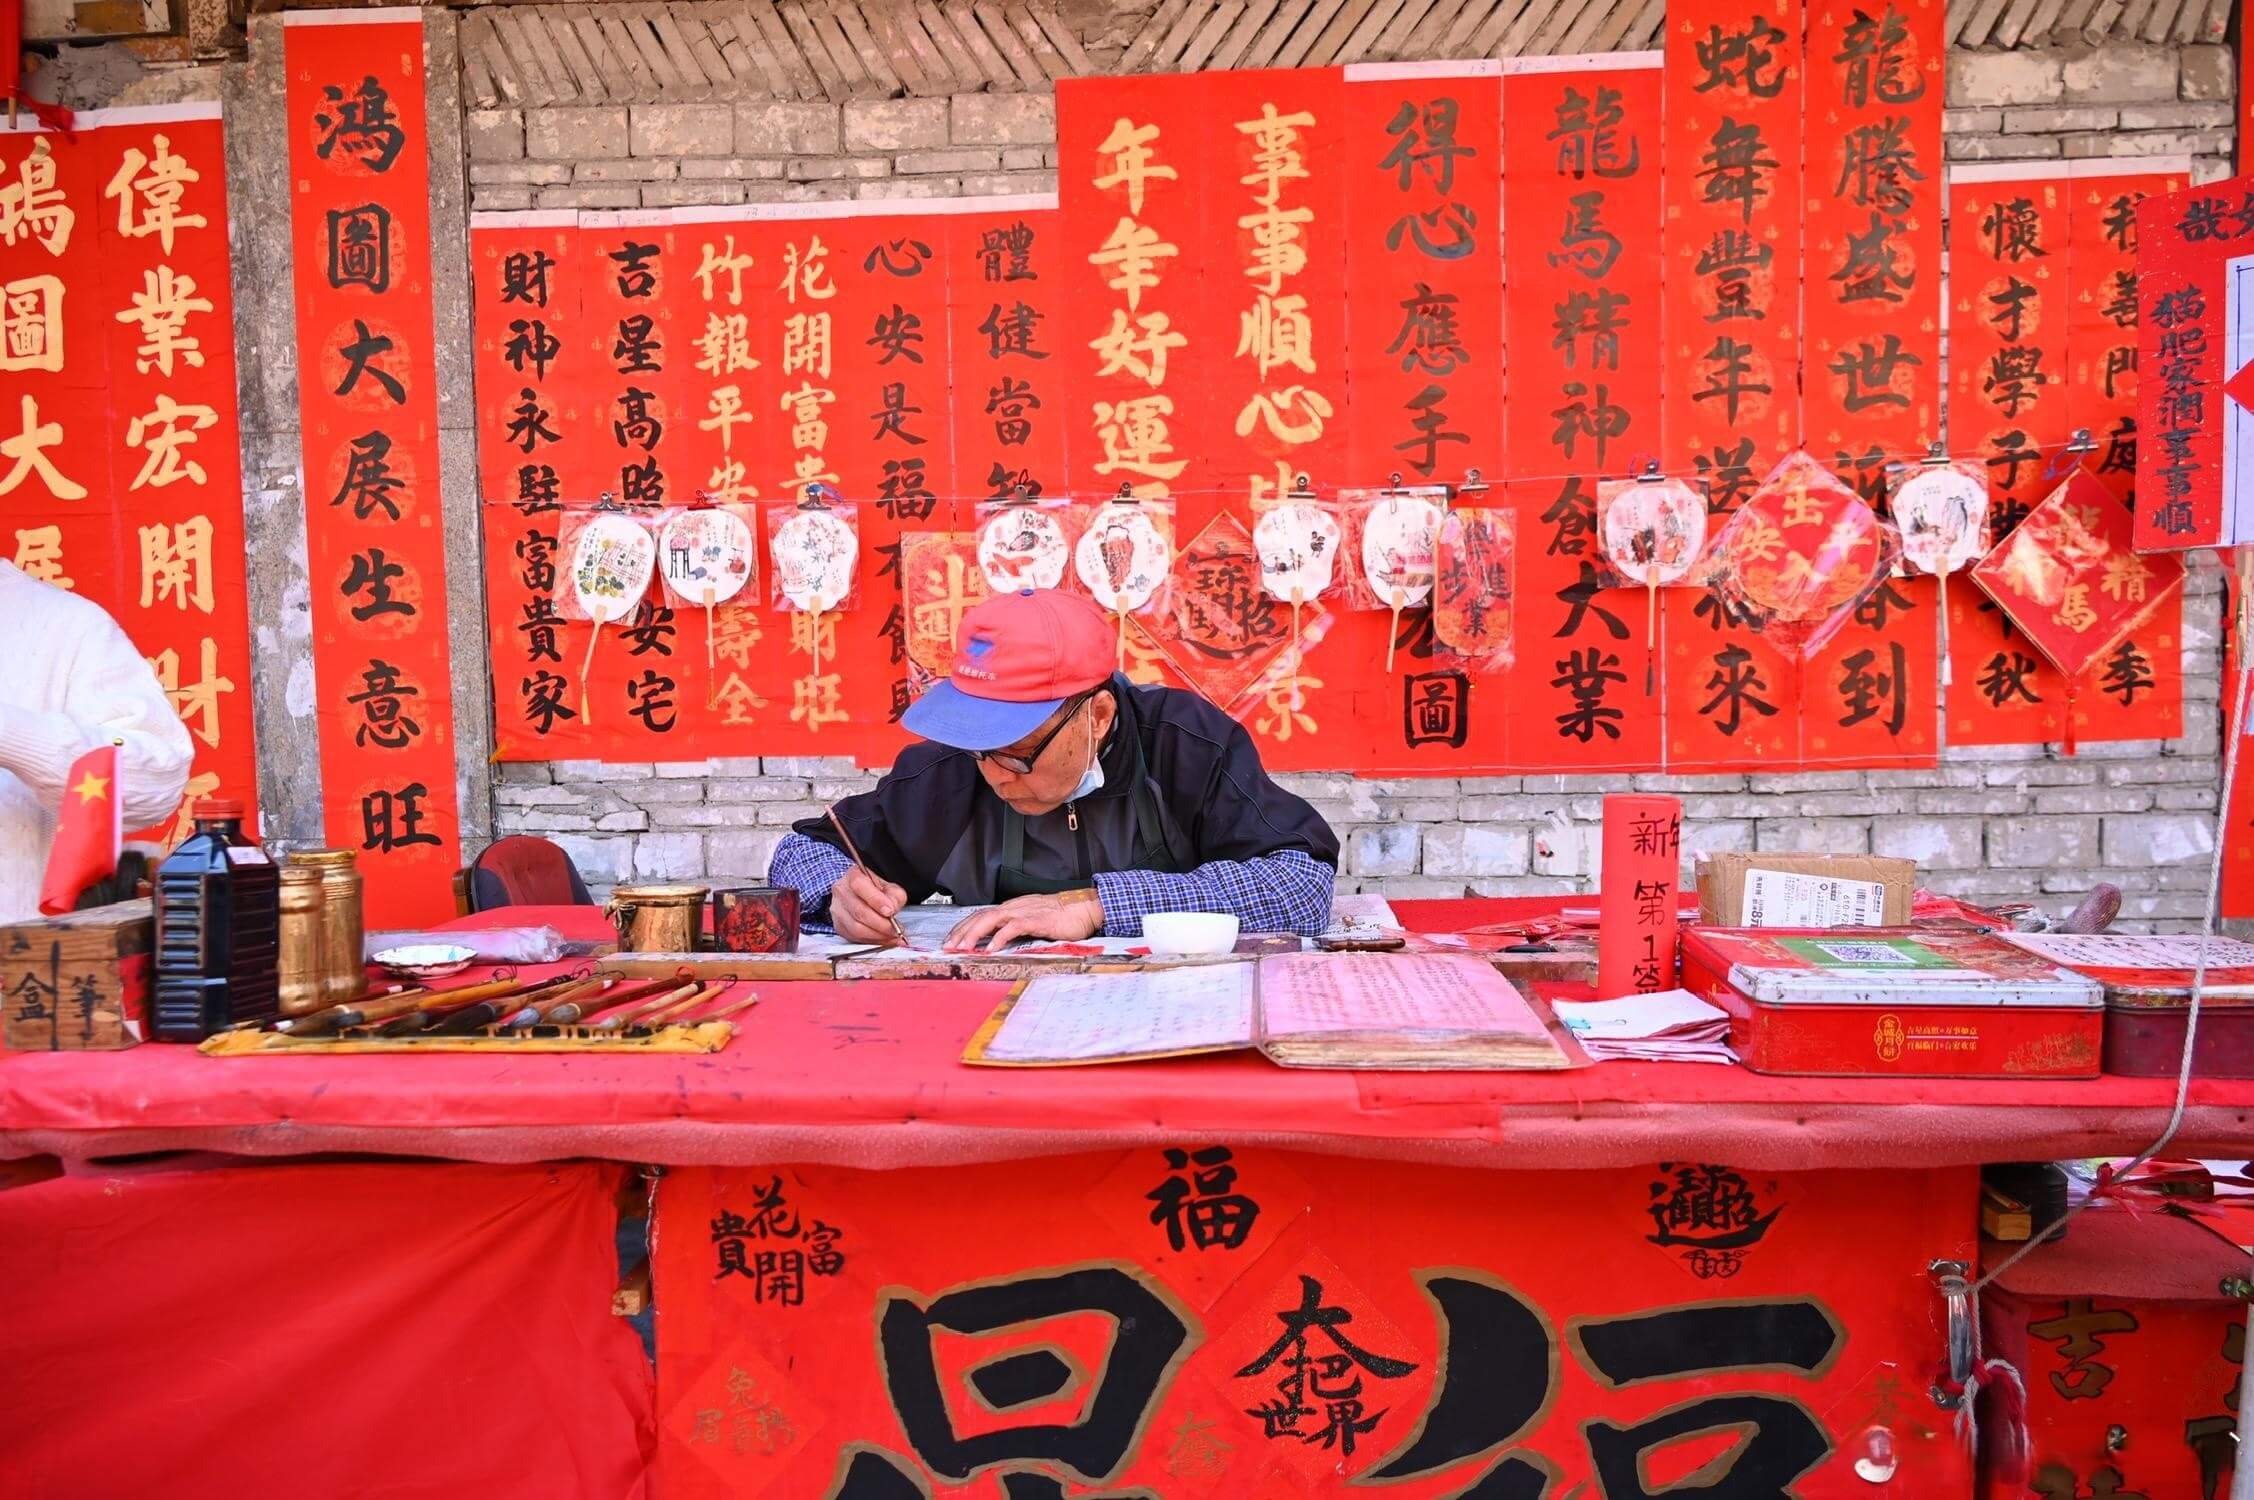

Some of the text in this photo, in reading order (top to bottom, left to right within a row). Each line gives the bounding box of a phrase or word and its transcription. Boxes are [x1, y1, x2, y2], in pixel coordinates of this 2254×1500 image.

[314, 75, 444, 854] 鴻圖大展生意旺
[500, 250, 577, 735] 財神永駐富貴家
[608, 240, 678, 733] 吉星高照安宅
[691, 233, 769, 725] 竹報平安壽全
[779, 234, 849, 733] 花開富貴財旺
[1376, 96, 1477, 750] 得心應手圖
[1540, 84, 1640, 743] 龍馬精神創大業
[1692, 15, 1788, 738] 蛇舞豐年送來
[1827, 4, 1929, 737] 龍騰盛世到
[1976, 197, 2050, 709] 懷才學子秋
[1144, 1145, 1261, 1254] 福
